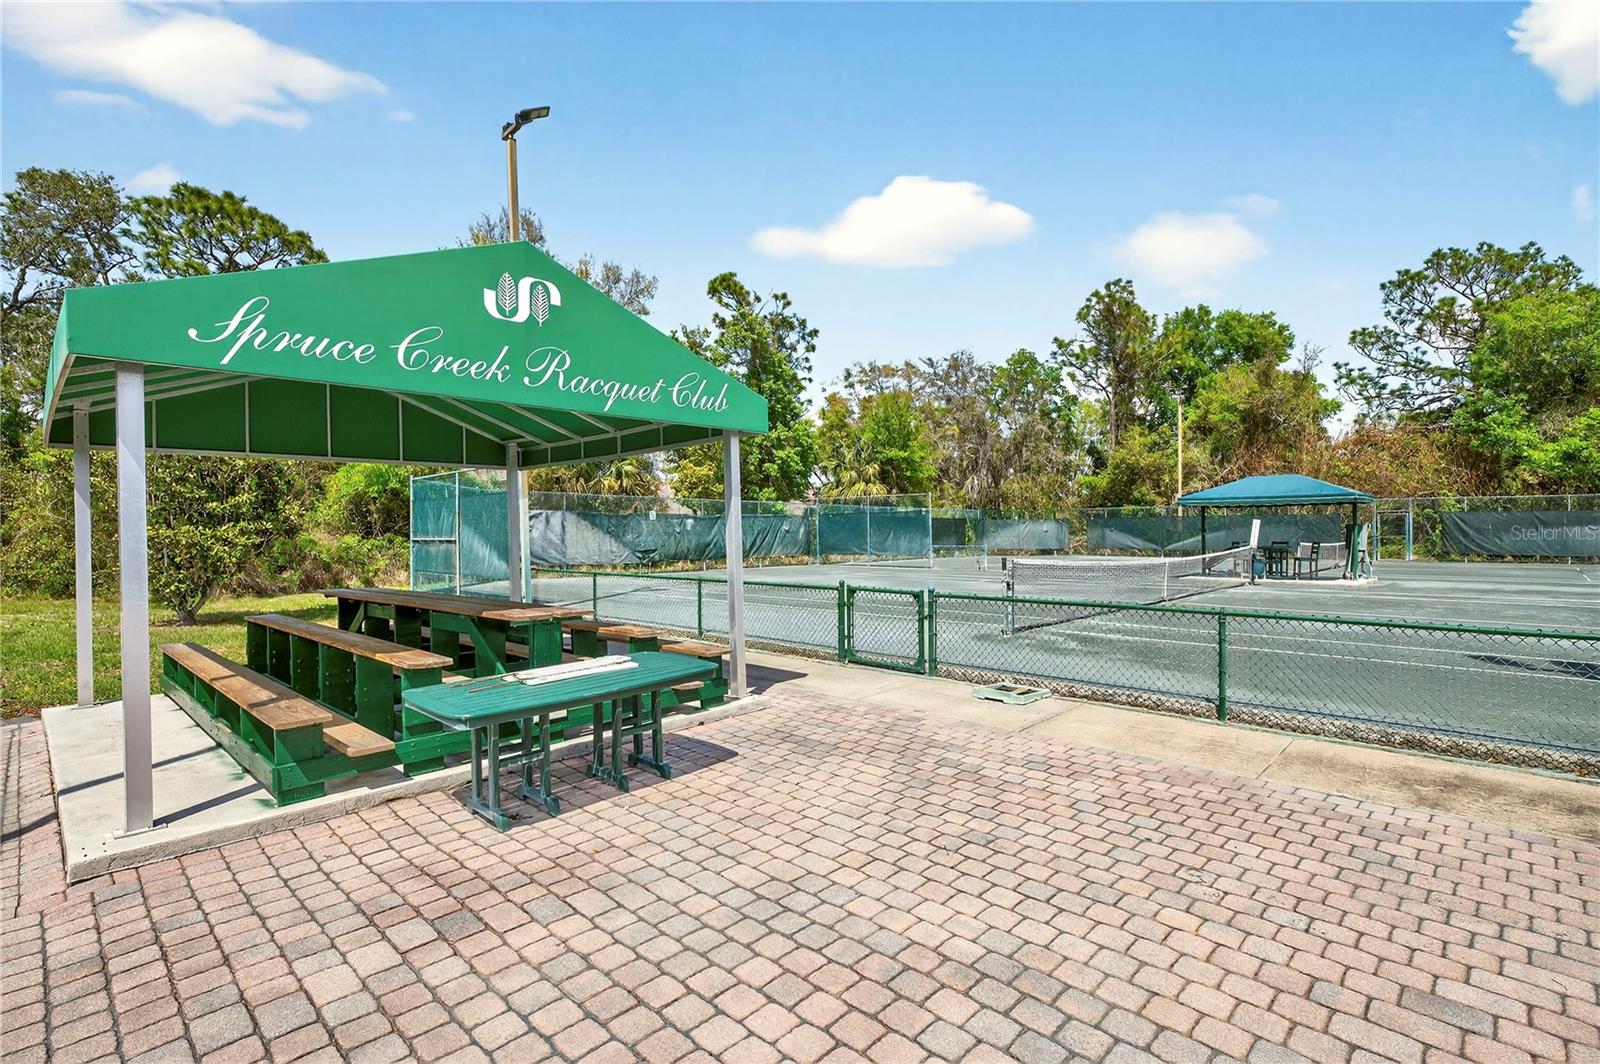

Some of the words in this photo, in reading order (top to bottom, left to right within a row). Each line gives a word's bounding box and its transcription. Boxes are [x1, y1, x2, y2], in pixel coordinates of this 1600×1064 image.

[187, 296, 376, 365] Spruce
[390, 326, 511, 383] Creek
[523, 346, 666, 412] Racquet
[668, 372, 729, 413] Club
